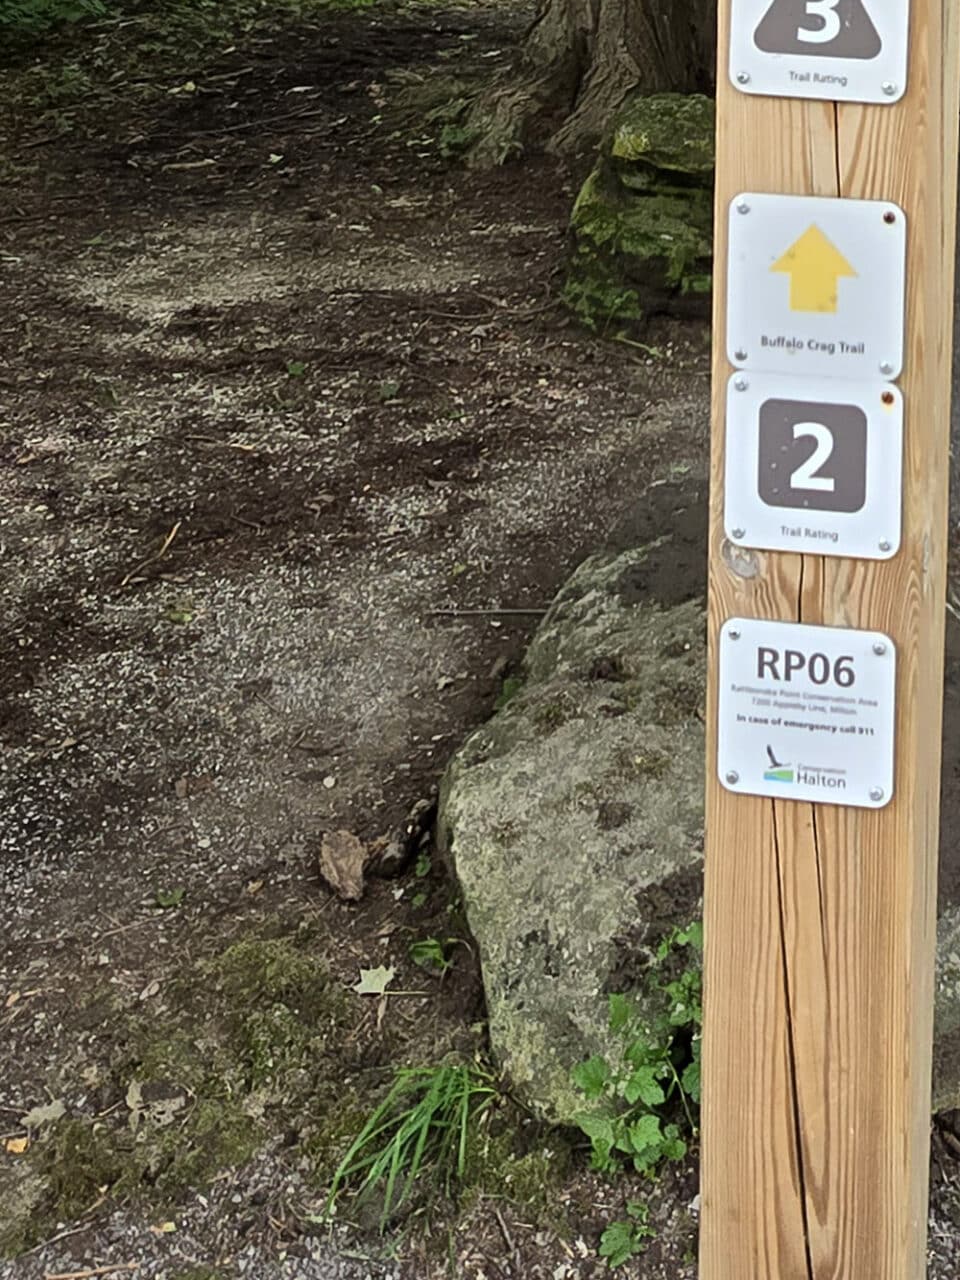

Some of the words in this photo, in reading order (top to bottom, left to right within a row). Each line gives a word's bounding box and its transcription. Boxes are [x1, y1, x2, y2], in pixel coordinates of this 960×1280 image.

[790, 70, 811, 82] Trail
[813, 72, 848, 88] Rating
[761, 335, 804, 350] Buffalo
[807, 339, 836, 356] Crag
[839, 341, 865, 355] Trail
[790, 421, 835, 492] 2
[781, 525, 802, 537] Trail
[804, 527, 839, 543] Rating
[757, 646, 856, 689] RP06
[736, 713, 746, 722] In
[748, 716, 769, 725] case
[771, 717, 782, 725] of
[784, 719, 837, 734] emergency
[839, 724, 856, 734] call
[858, 726, 875, 736] 911
[797, 770, 847, 790] Halton
